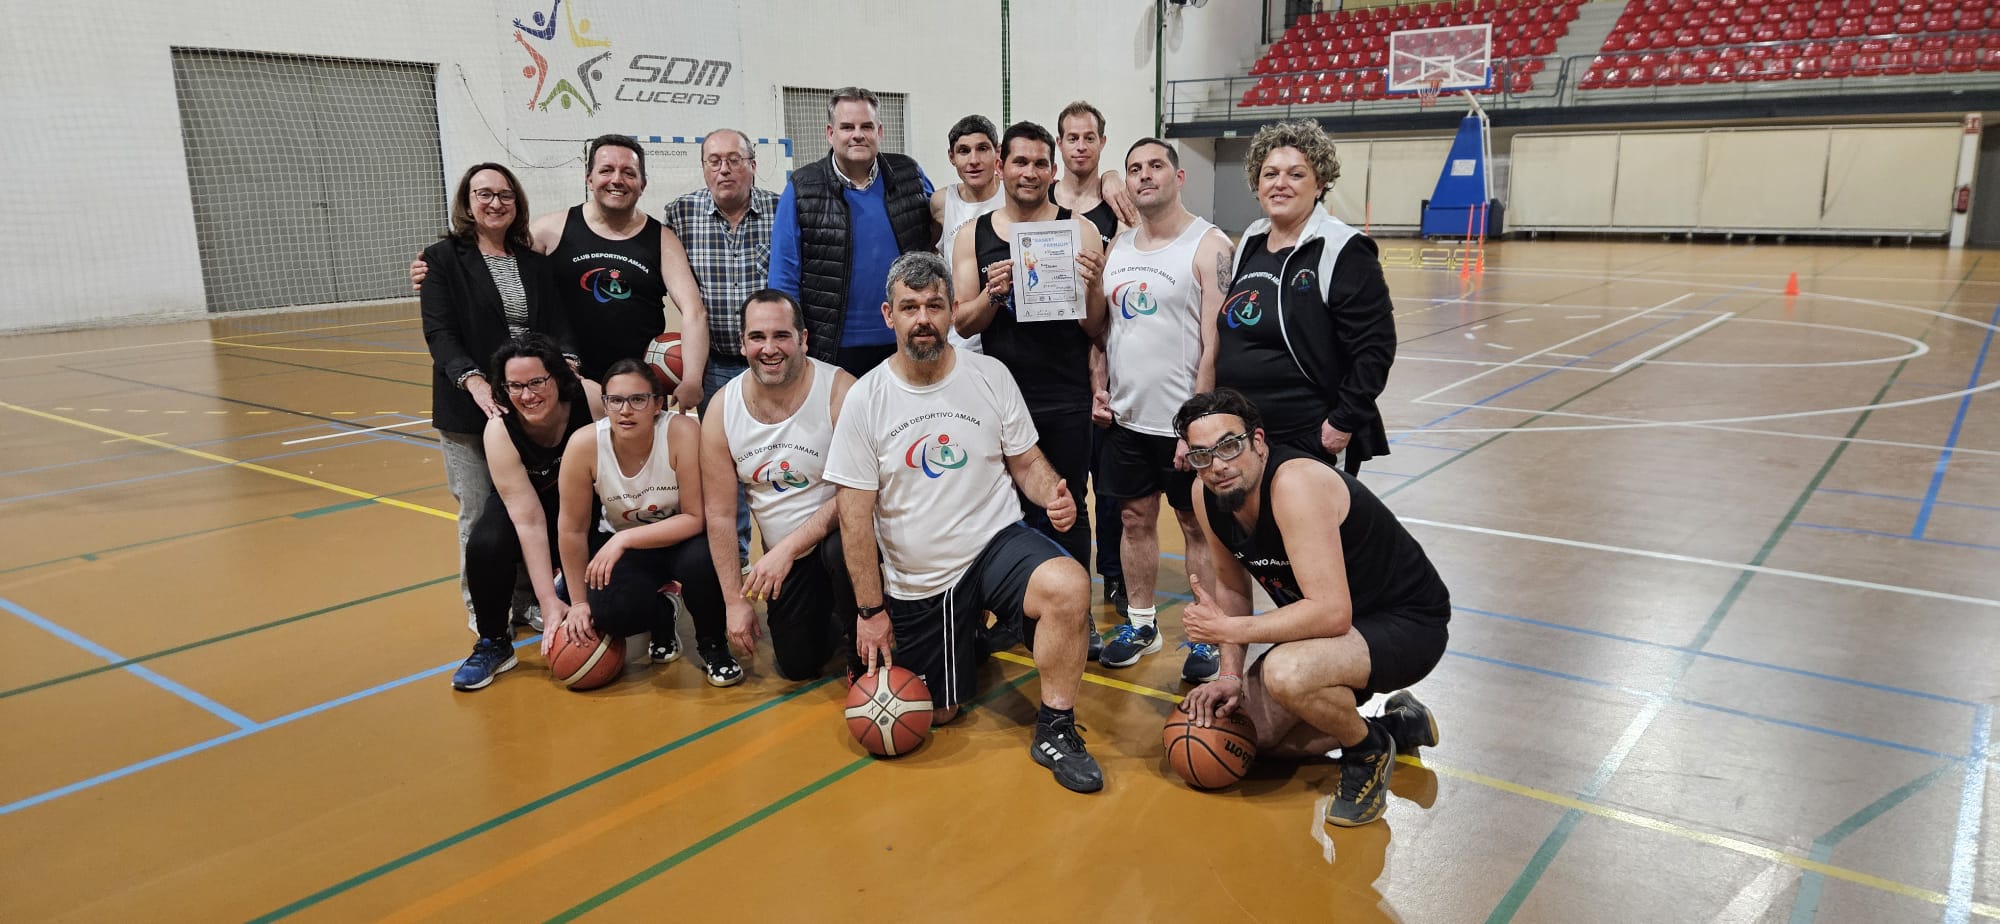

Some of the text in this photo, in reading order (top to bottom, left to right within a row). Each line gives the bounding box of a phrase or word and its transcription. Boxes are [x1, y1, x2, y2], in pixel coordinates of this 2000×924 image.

[622, 54, 732, 88] SDM
[615, 84, 721, 106] Lucena
[572, 252, 649, 274] CLUB DEPORTIVO AMARA
[1110, 266, 1176, 286] CLUB DEPORTIVO AMARA
[890, 411, 981, 437] CLUB DEPORTIVO AMARA
[737, 443, 819, 463] CLUB DEPORTIVO AMARA
